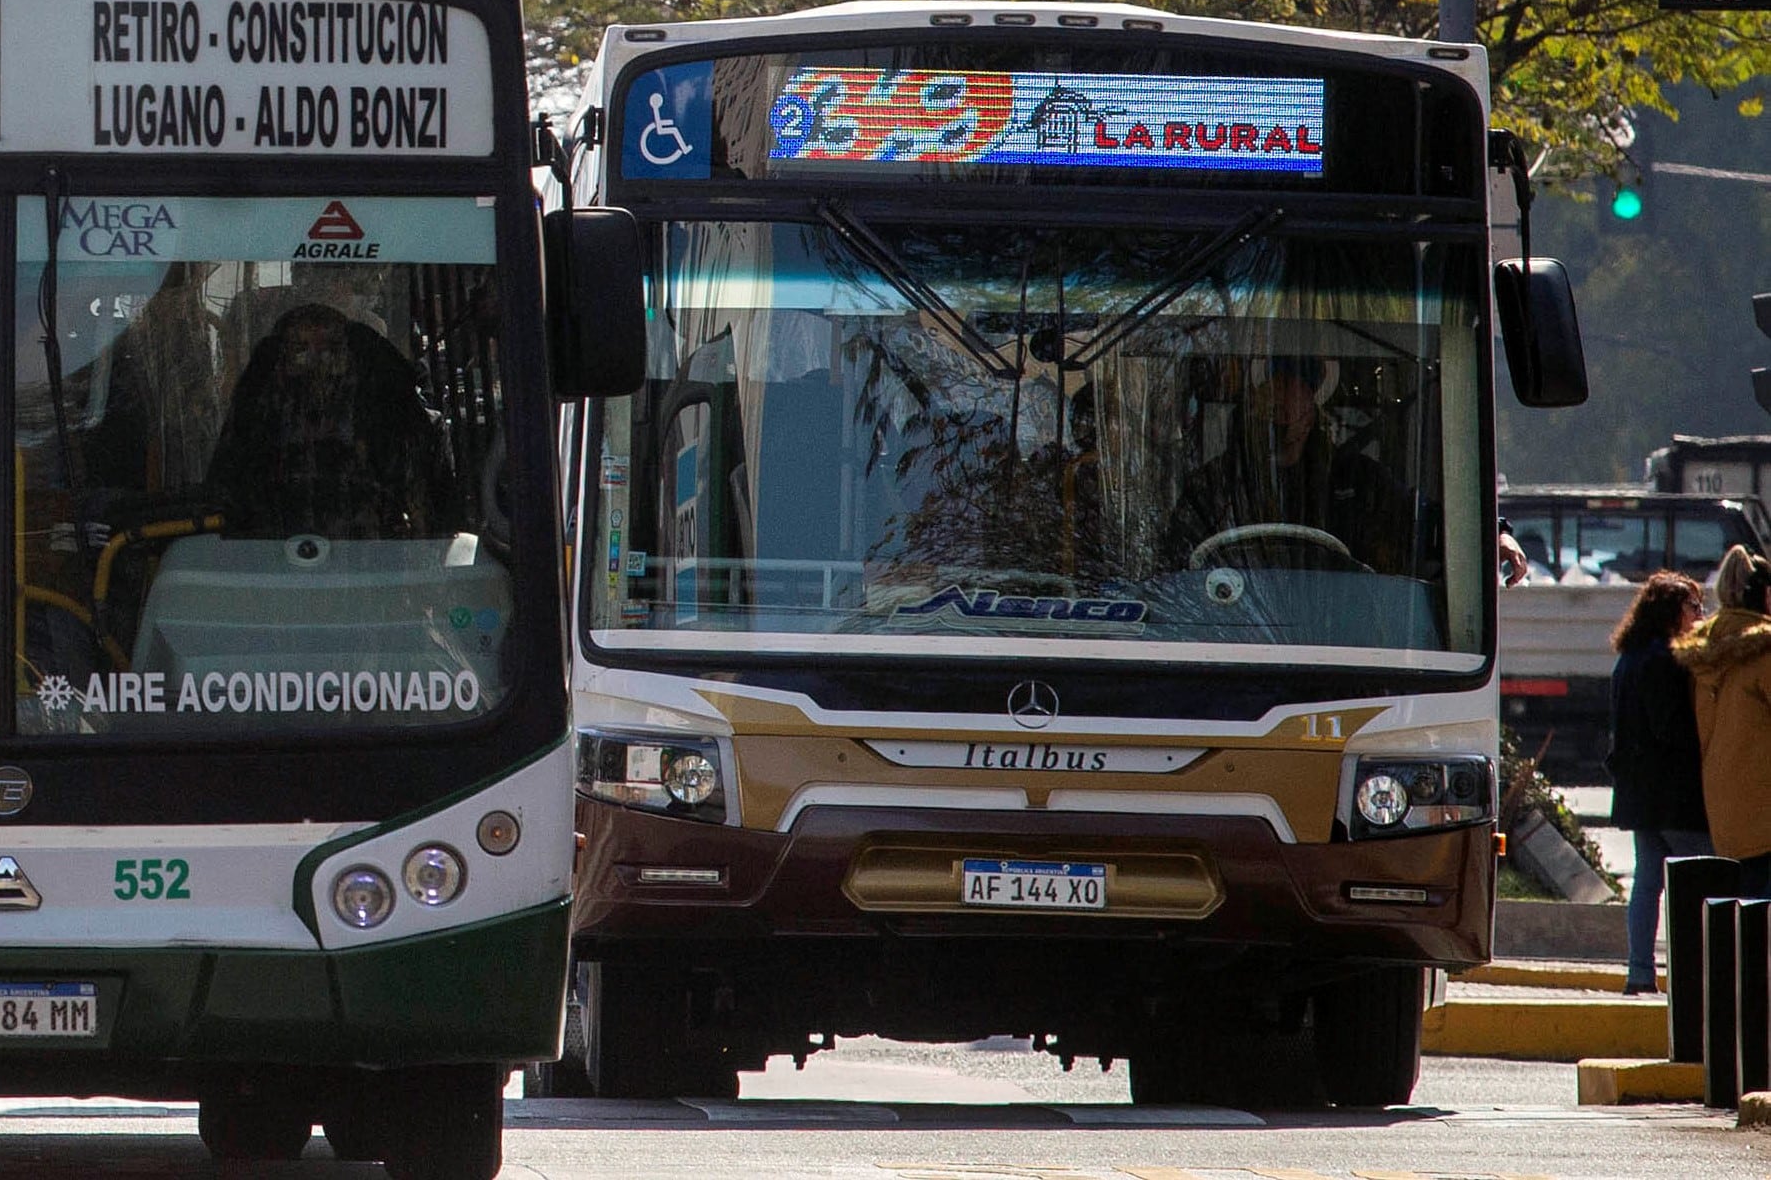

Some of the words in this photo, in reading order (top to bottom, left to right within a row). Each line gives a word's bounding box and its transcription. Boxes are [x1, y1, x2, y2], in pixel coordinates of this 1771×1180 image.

[93, 1, 200, 63] RETIRO
[227, 1, 448, 65] CONSTITUCION
[93, 84, 226, 147] LUGANO
[254, 86, 339, 148] ALDO
[350, 86, 448, 149] BONZI
[1095, 121, 1154, 150] LA
[1164, 121, 1322, 154] RURAL
[59, 201, 176, 231] MEGA
[80, 228, 161, 257] CAR
[293, 243, 380, 259] AGRALE
[82, 672, 166, 712] AIRE
[177, 670, 480, 712] ACONDICIONADO
[963, 742, 1108, 771] Italbus
[114, 859, 191, 901] 552
[971, 876, 1001, 900] AF
[1011, 877, 1058, 902] 144
[1068, 879, 1098, 904] XO
[51, 1000, 89, 1031] MM
